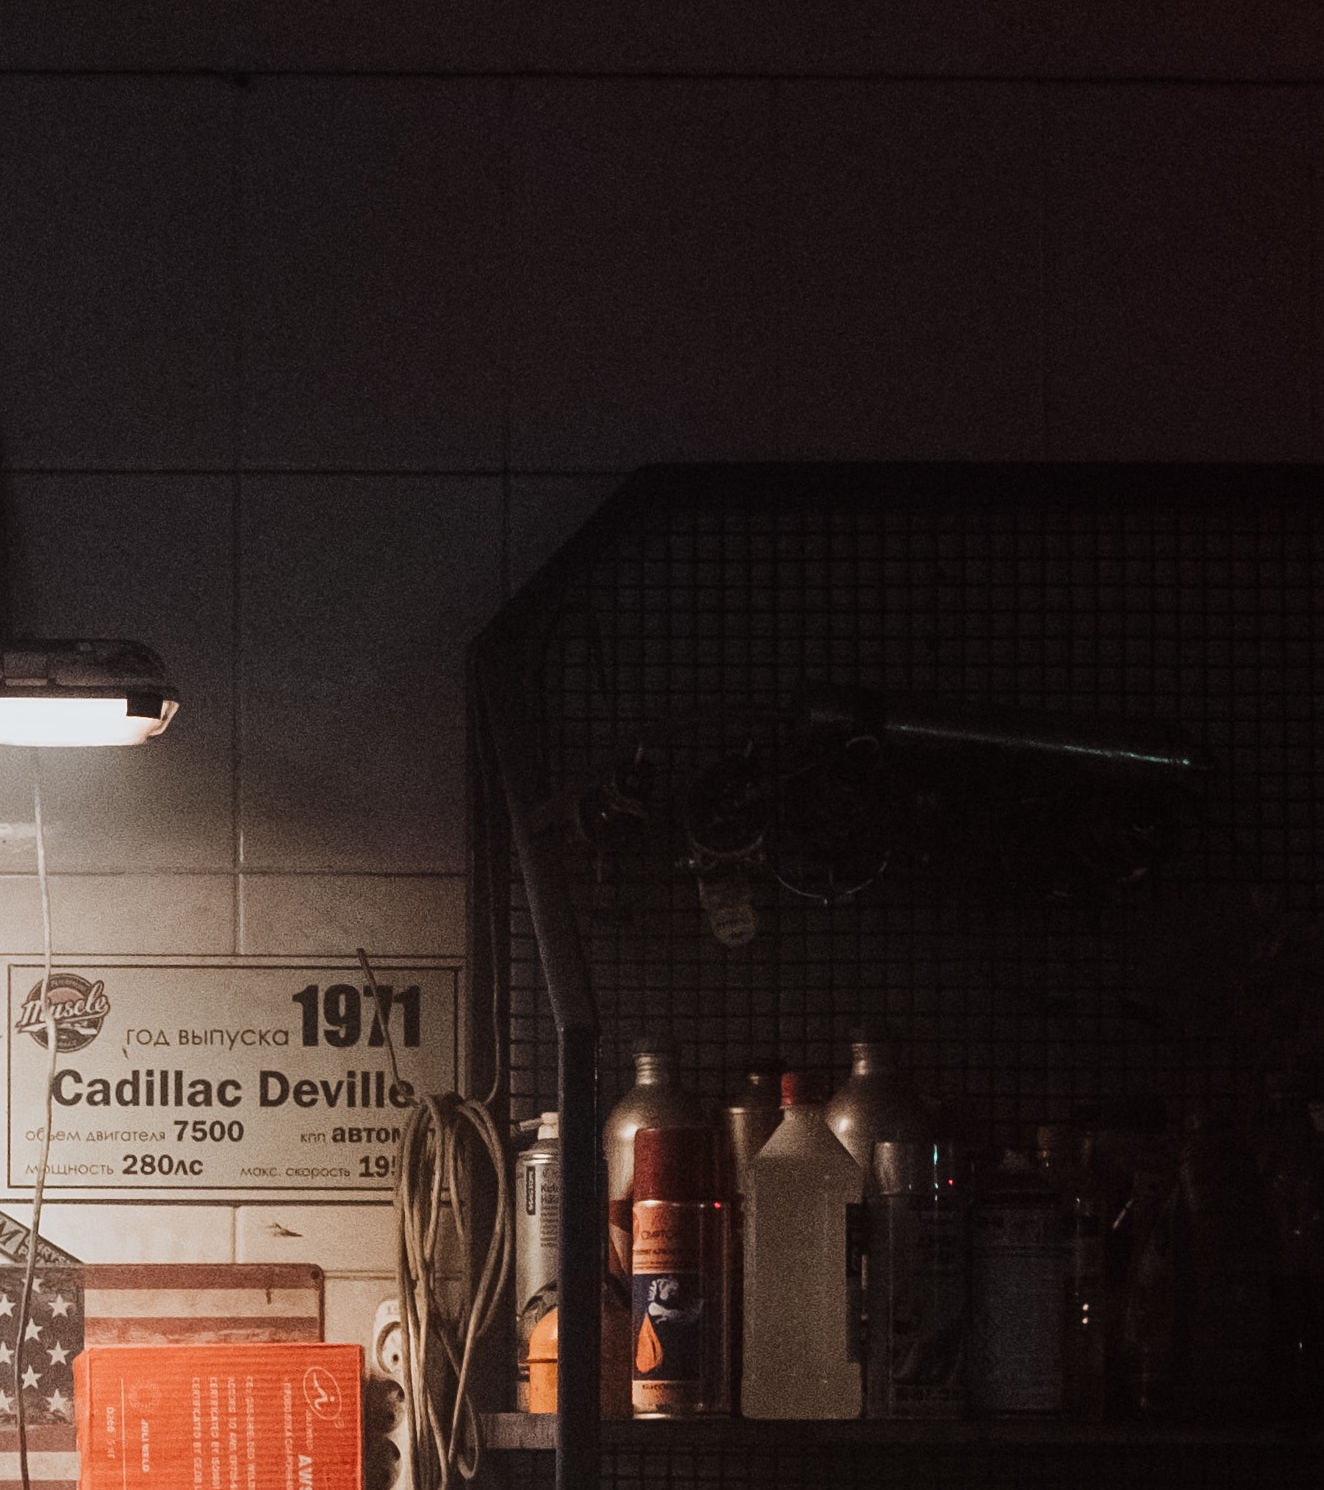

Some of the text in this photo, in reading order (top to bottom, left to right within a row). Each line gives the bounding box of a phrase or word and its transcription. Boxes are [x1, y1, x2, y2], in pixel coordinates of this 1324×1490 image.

[15, 979, 111, 1030] Muscle
[126, 984, 422, 1052] год выпуска 1971
[52, 1068, 415, 1109] Cadillac Deville
[25, 1127, 81, 1143] обем
[85, 1130, 166, 1143] двигателя
[173, 1120, 245, 1143] 7500
[300, 1132, 327, 1144] кпп
[122, 1154, 204, 1176] 280лс
[285, 1166, 351, 1179] скорость
[358, 1155, 397, 1179] 19
